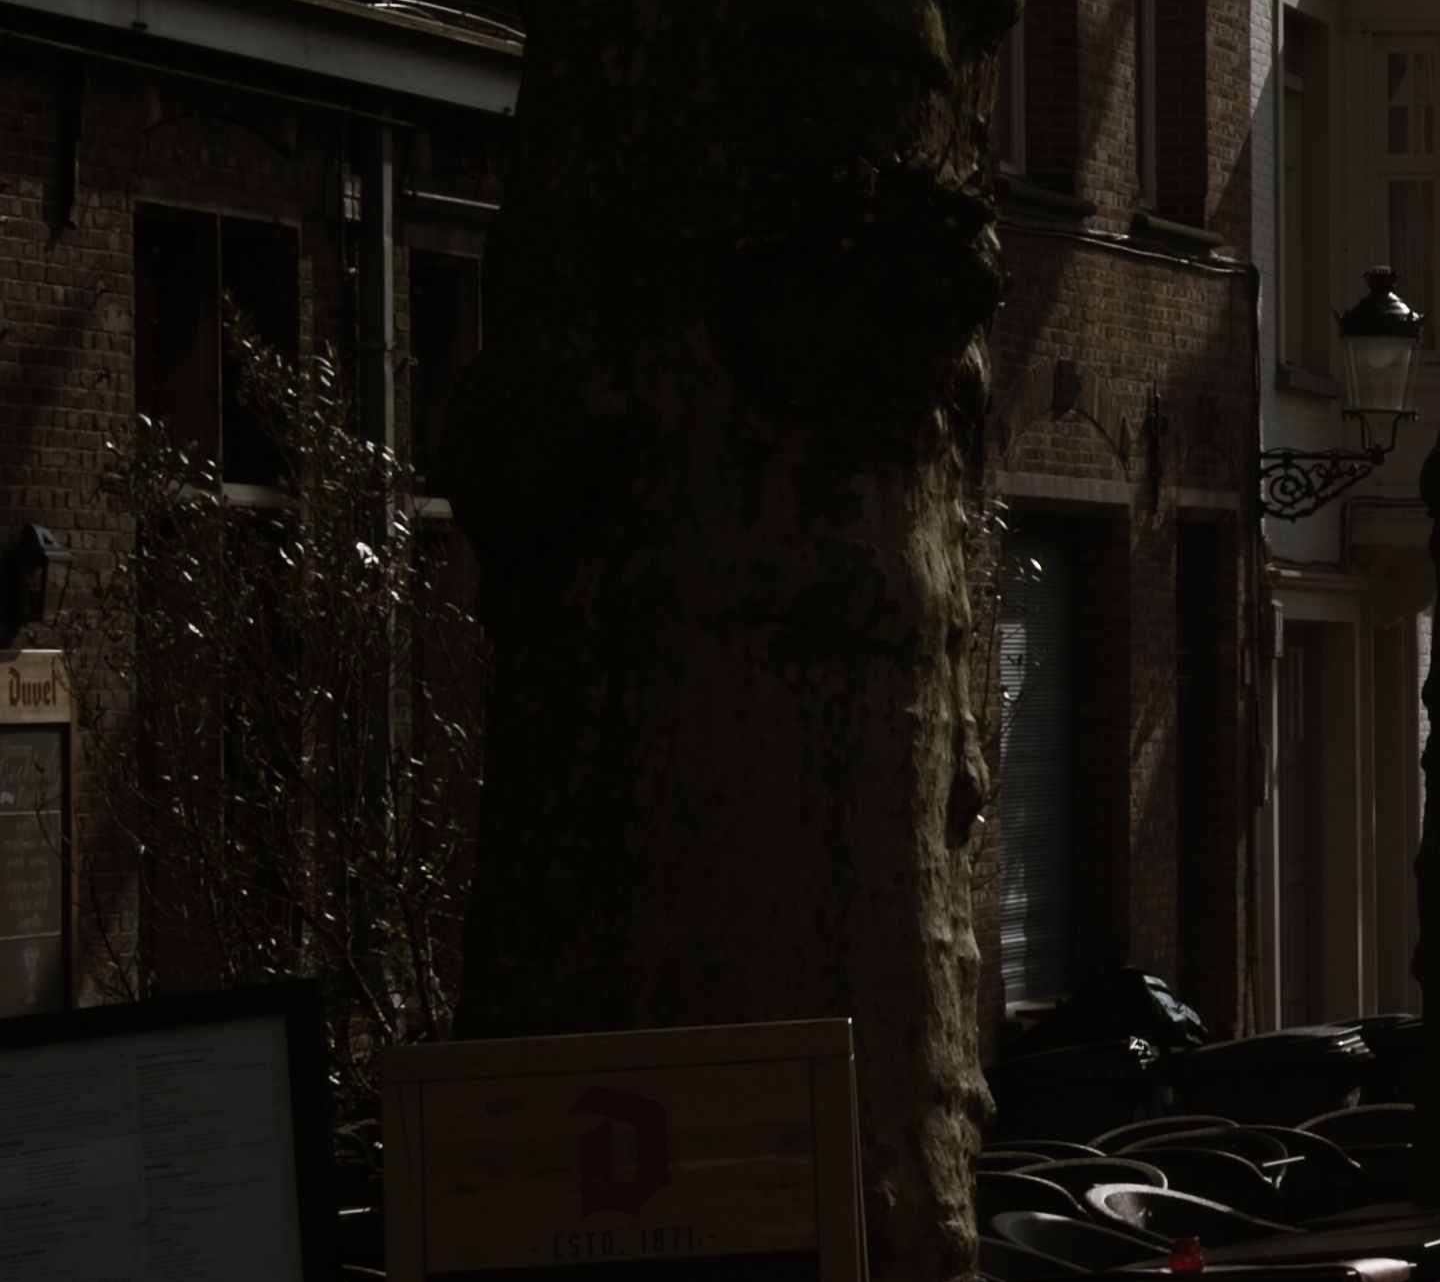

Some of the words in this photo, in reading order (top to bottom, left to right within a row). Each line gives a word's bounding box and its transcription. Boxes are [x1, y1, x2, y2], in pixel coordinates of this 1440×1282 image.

[9, 658, 57, 706] Duvel
[554, 1230, 626, 1258] ESTD.
[640, 1226, 695, 1252] 1871
